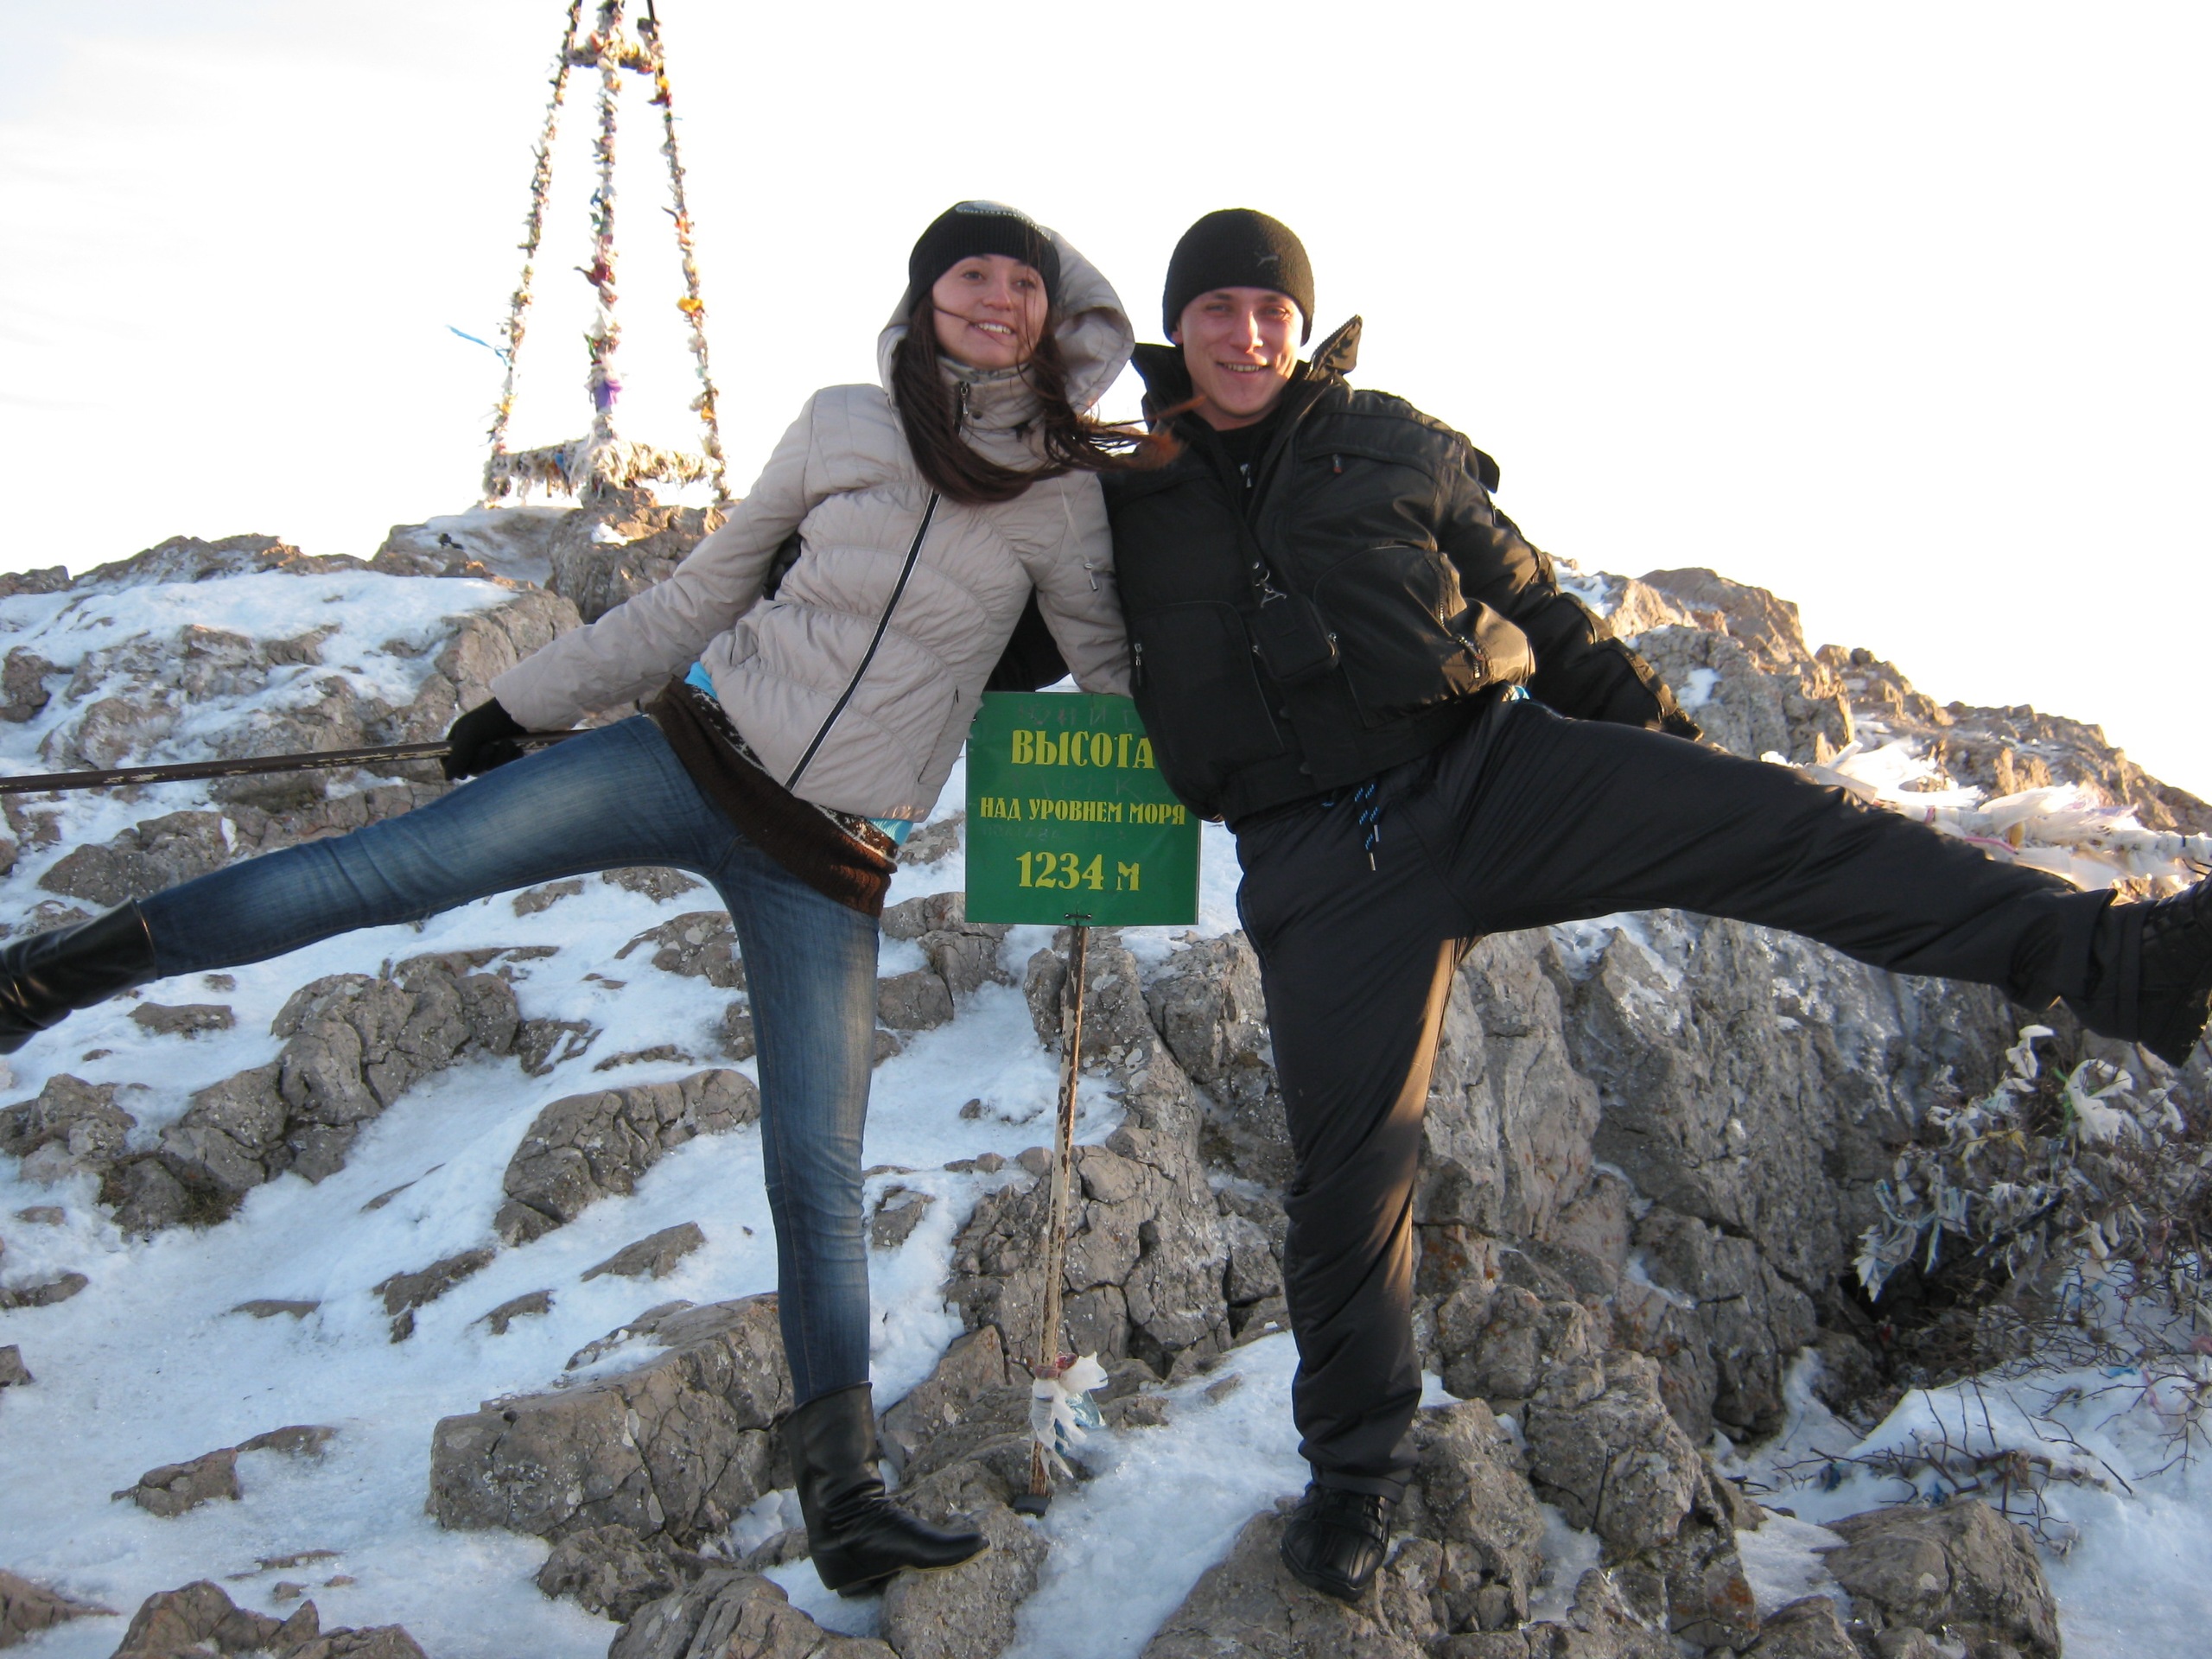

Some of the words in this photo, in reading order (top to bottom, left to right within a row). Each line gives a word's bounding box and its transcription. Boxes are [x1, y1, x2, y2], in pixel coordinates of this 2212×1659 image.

[1011, 729, 1154, 769] ВЫСОТА
[980, 797, 1020, 820] НАД
[1028, 799, 1122, 823] УРОВНЕМ
[1128, 803, 1185, 825] МОРЯ
[1015, 851, 1103, 890] 1234
